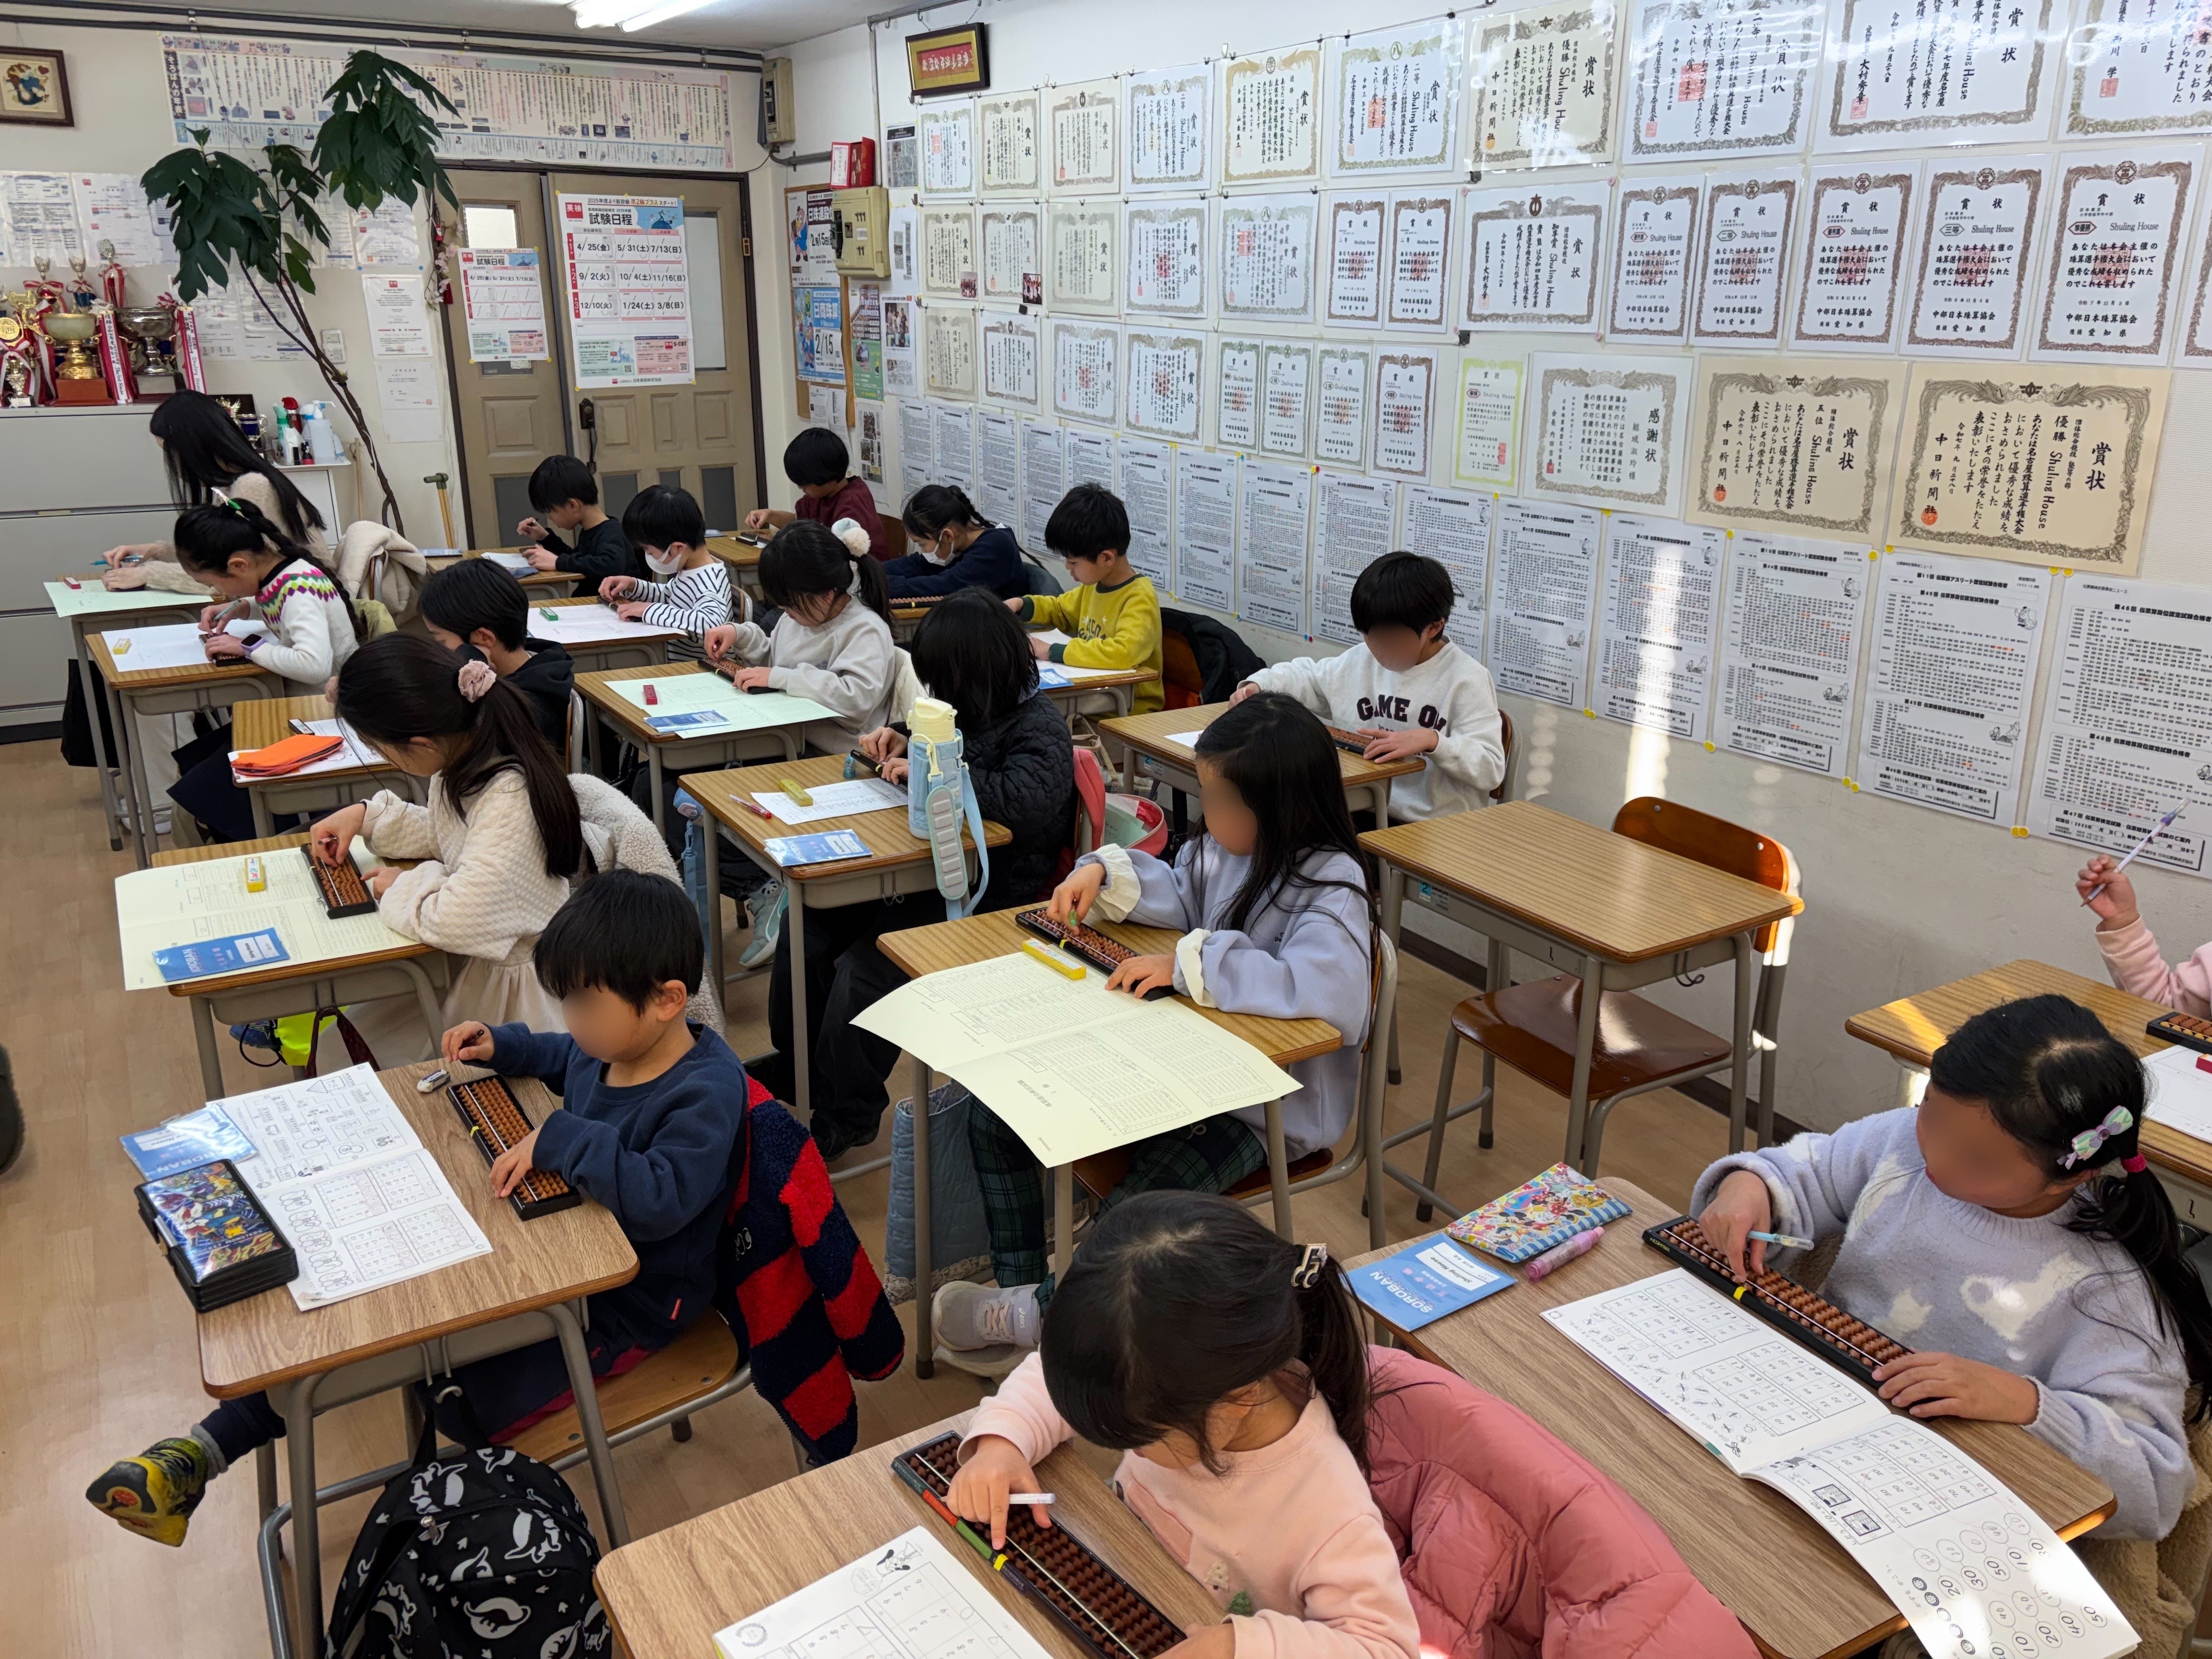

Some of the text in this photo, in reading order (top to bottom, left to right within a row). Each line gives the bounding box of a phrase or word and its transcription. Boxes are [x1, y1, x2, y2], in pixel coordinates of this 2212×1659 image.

[2001, 7, 2023, 64] 賞状
[1555, 39, 1571, 106] 優勝 Shuling
[1771, 38, 1791, 94] 賞状
[1582, 56, 1597, 98] 賞状
[1856, 59, 1870, 105] 大村秀章
[1960, 68, 1975, 100] House
[1300, 91, 1308, 126] 賞状
[1409, 63, 1420, 153] 二等 Shuling House
[1429, 80, 1440, 123] 賞状
[1486, 71, 1500, 141] 中日新聞社
[1741, 95, 1751, 126] House
[1025, 127, 1031, 157] 賞状
[566, 204, 582, 212] 英検
[1841, 201, 1878, 214] 賞状
[1961, 198, 2002, 210] 賞状
[2098, 193, 2145, 206] 賞状
[589, 213, 633, 225] 試験日程
[1643, 211, 1672, 222] 賞状
[1733, 206, 1765, 218] 賞状
[1410, 219, 1432, 227] 賞状
[1850, 227, 1888, 236] Shuling House
[1971, 225, 1994, 234] Shuling
[1996, 224, 2014, 233] House
[2110, 222, 2159, 232] Shuling House
[1650, 234, 1666, 242] Shuling
[1741, 229, 1777, 239] Shuling House
[651, 245, 681, 254] 7/13(日)
[1821, 245, 1888, 253] あなたは本会主催の
[2072, 242, 2158, 251] あなたは本会主催の
[1100, 242, 1107, 272] 賞状
[1189, 242, 1197, 276] 賞状
[1290, 246, 1298, 278] 賞状
[1546, 223, 1559, 308] 知事賞 Shuling House
[1571, 238, 1583, 279] 賞状
[1714, 257, 1774, 266] 珠算選手権大会において
[1820, 256, 1887, 264] 珠算選手権大会において
[1936, 256, 2012, 264] 珠算選手権大会において
[2069, 255, 2157, 264] 珠算選手権大会において
[1934, 267, 2010, 275] 優秀な成績を収められた
[2067, 268, 2153, 276] 優秀な成績を収められた
[2066, 280, 2135, 289] のでこれを賞します
[623, 302, 654, 310] 1/24(土)
[658, 302, 684, 310] 3/8(日)
[814, 302, 838, 319] 日商珠算
[1626, 306, 1670, 314] 中部日本珠算協会
[1713, 306, 1763, 314] 中部日本珠算協会
[1816, 308, 1872, 317] 中部日本珠算協会
[1933, 310, 1996, 320] 中部日本珠算協会
[2066, 313, 2137, 324] 中部日本珠算協会
[815, 334, 833, 356] 2/15
[1105, 361, 1112, 391] 賞状
[1334, 366, 1352, 376] 賞状
[1393, 373, 1414, 382] 賞状
[1187, 372, 1195, 404] 賞状
[1616, 397, 1627, 483] あなたは名古屋商工会
[1645, 408, 1660, 462] 感謝状
[1746, 401, 1760, 474] 表彰いたします
[1765, 402, 1781, 486] おさめられました
[1838, 427, 1859, 471] 賞状
[1963, 411, 1985, 494] 表彰いたします
[1716, 420, 1733, 492] 中日新聞社
[1753, 402, 1770, 505] ここにその栄誉をたたえ
[1774, 404, 1792, 508] において優秀な成績を
[1785, 403, 1805, 510] あなたは名古屋珠算選手権大会
[1804, 404, 1825, 505] 五位 Shuling House
[1989, 412, 2012, 506] おさめられました
[1925, 433, 1948, 514] 中日新聞社
[1972, 412, 1997, 530] ここにその栄誉をたたえ
[2000, 414, 2027, 533] において優秀な成績を
[2038, 415, 2069, 529] 優勝 Shuling House
[2085, 441, 2112, 490] 賞状
[2013, 414, 2042, 535] あなたは名古屋珠算選手権大会
[2114, 603, 2137, 612] 第46回
[225, 1229, 263, 1244] MONSTERS
[1430, 1256, 1448, 1272] House
[1449, 1269, 1473, 1284] Shuling
[1370, 1271, 1432, 1313] SOROBAN
[1881, 1489, 1892, 1498] 30
[2009, 1551, 2028, 1565] 10
[1987, 1560, 2006, 1576] 50
[1963, 1570, 1984, 1587] 30
[1940, 1579, 1961, 1596] 20
[2084, 1606, 2103, 1622] 50
[2061, 1616, 2080, 1634] 40
[2015, 1636, 2034, 1651] 10
[2038, 1626, 2059, 1644] 20
